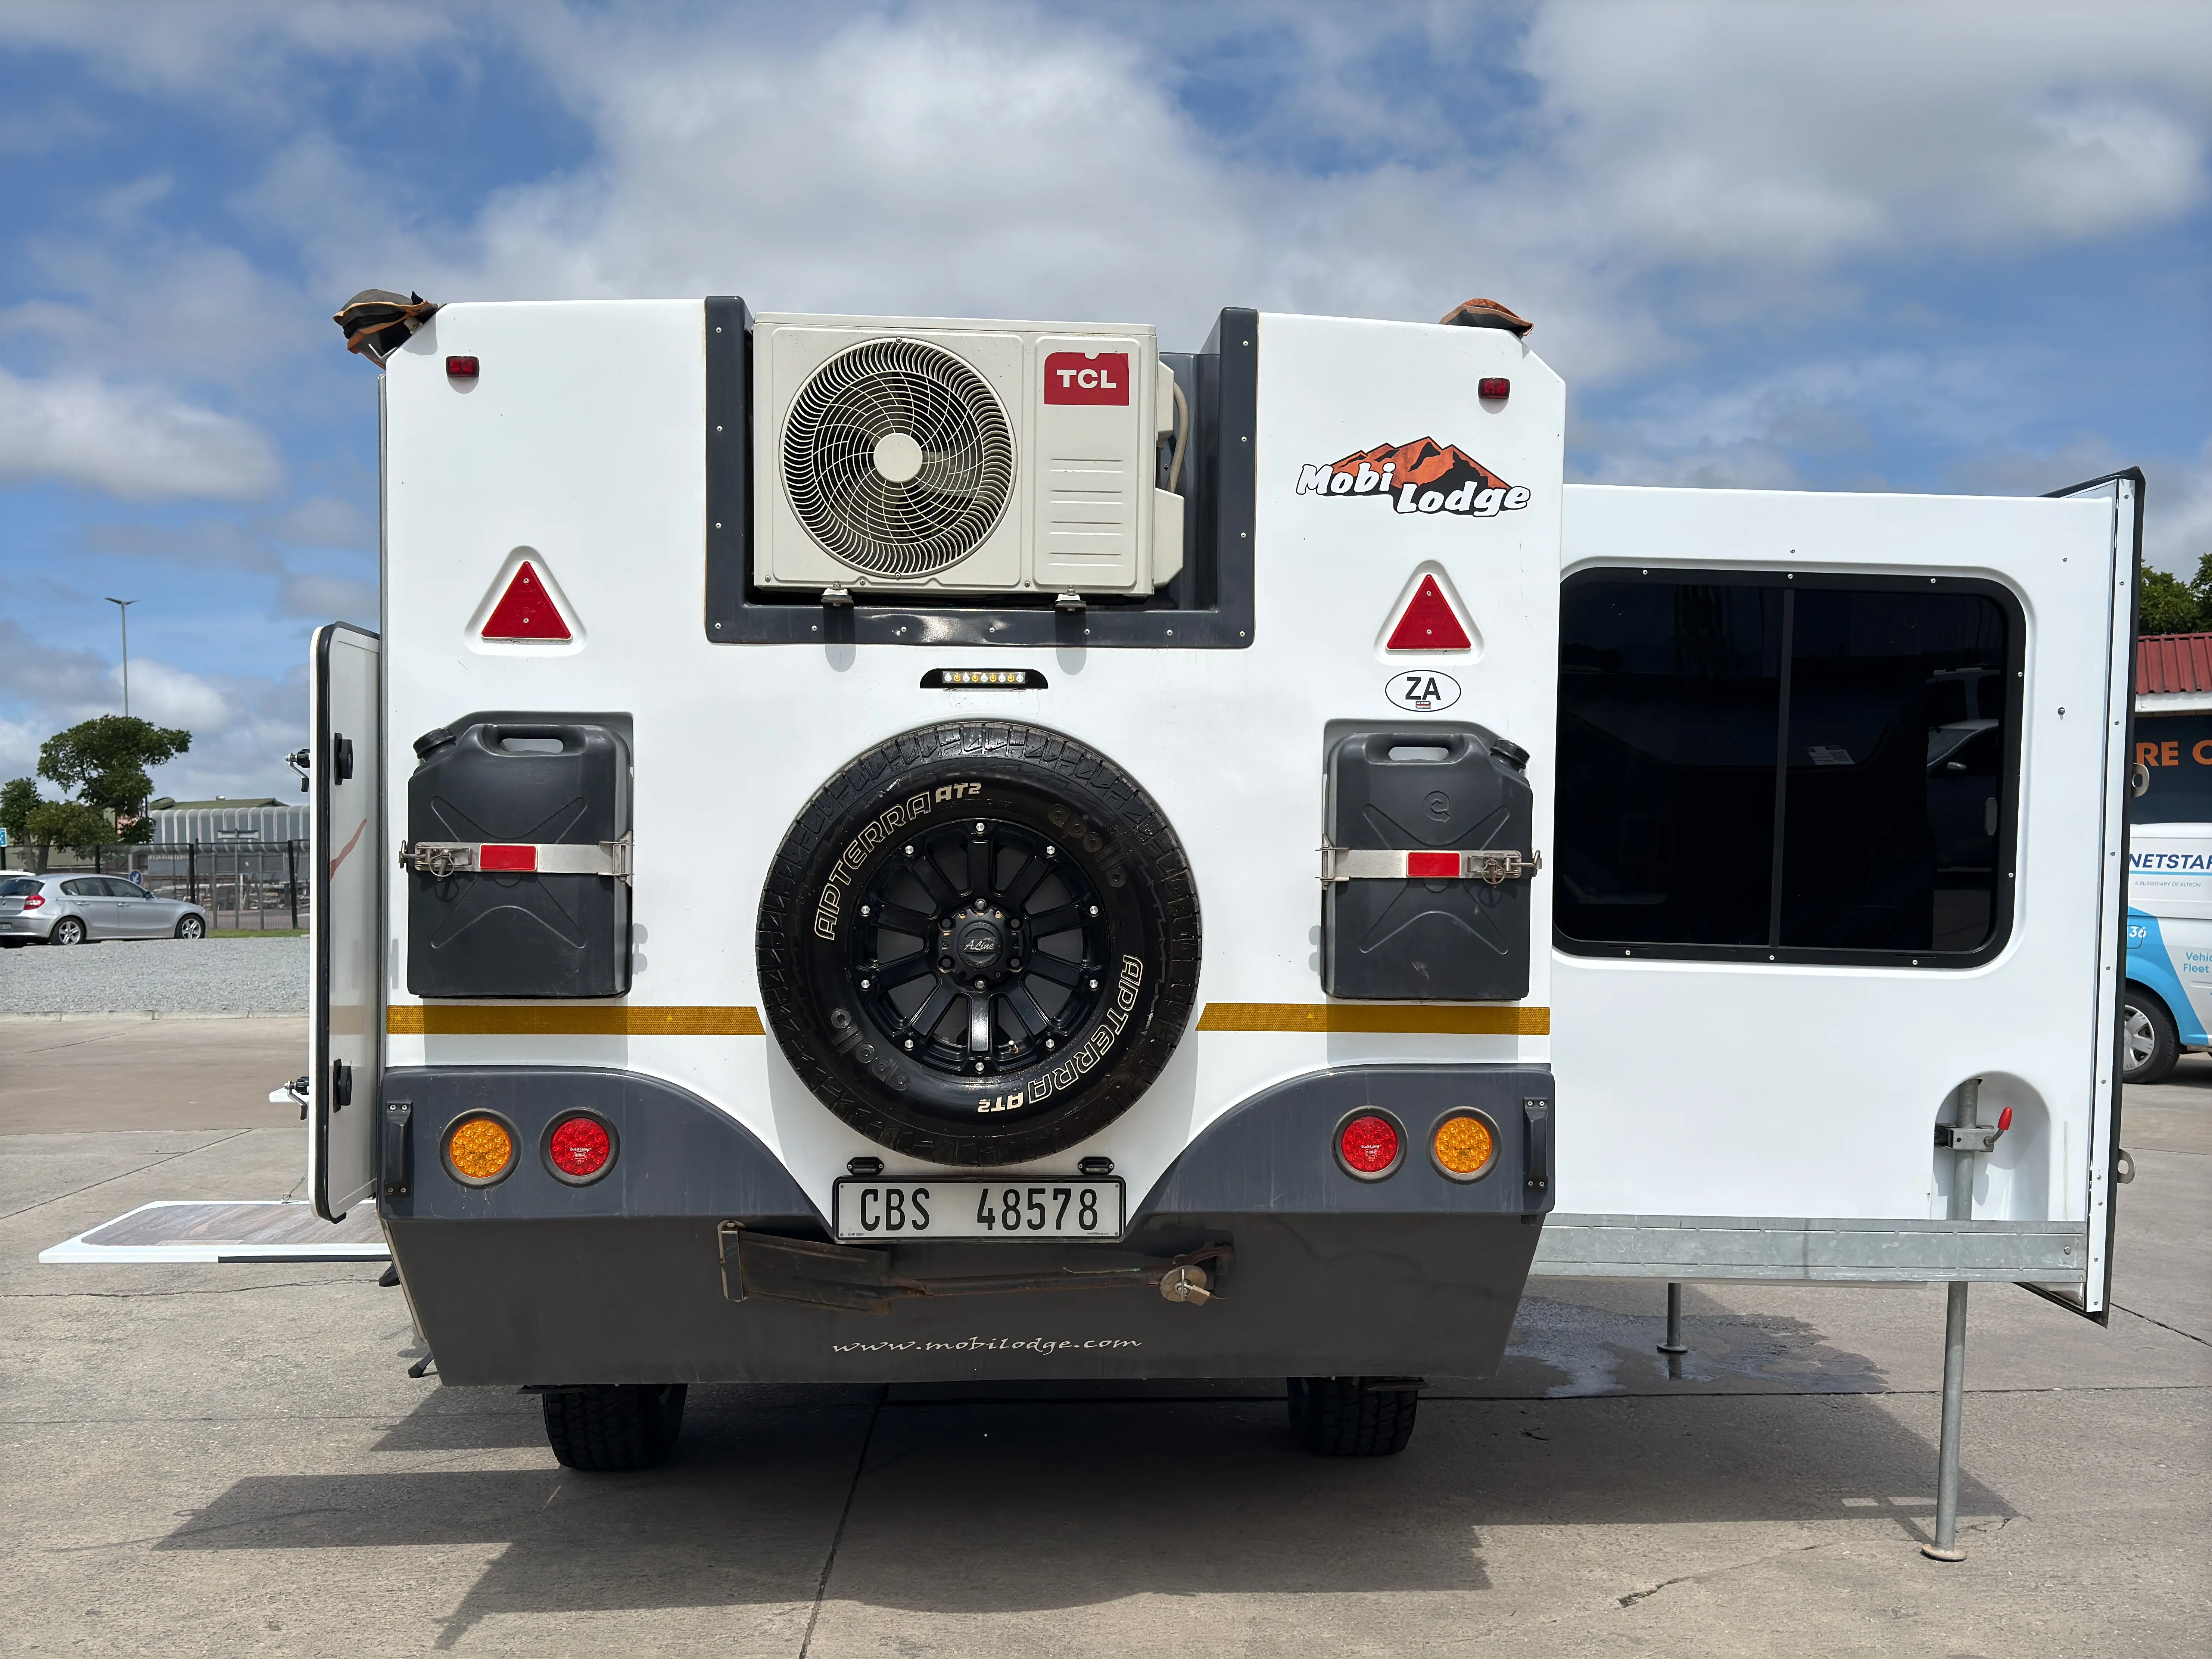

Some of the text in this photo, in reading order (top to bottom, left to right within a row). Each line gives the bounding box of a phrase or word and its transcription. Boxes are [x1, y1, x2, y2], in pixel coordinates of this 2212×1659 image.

[1056, 368, 1117, 389] TCL
[1296, 461, 1397, 495] Mobi
[1396, 481, 1531, 517] Lodge
[1405, 676, 1442, 700] ZA
[2136, 741, 2179, 766] RE
[813, 782, 981, 941] APTERRA AT2
[1048, 804, 1127, 888] apollo
[2129, 926, 2147, 938] 36
[2183, 963, 2210, 973] Fleet
[831, 1007, 911, 1091] apollo
[977, 954, 1144, 1113] APTERRA AT2
[860, 1188, 1098, 1231] CBS 48578
[832, 1336, 1142, 1355] www.mobilodge.com
